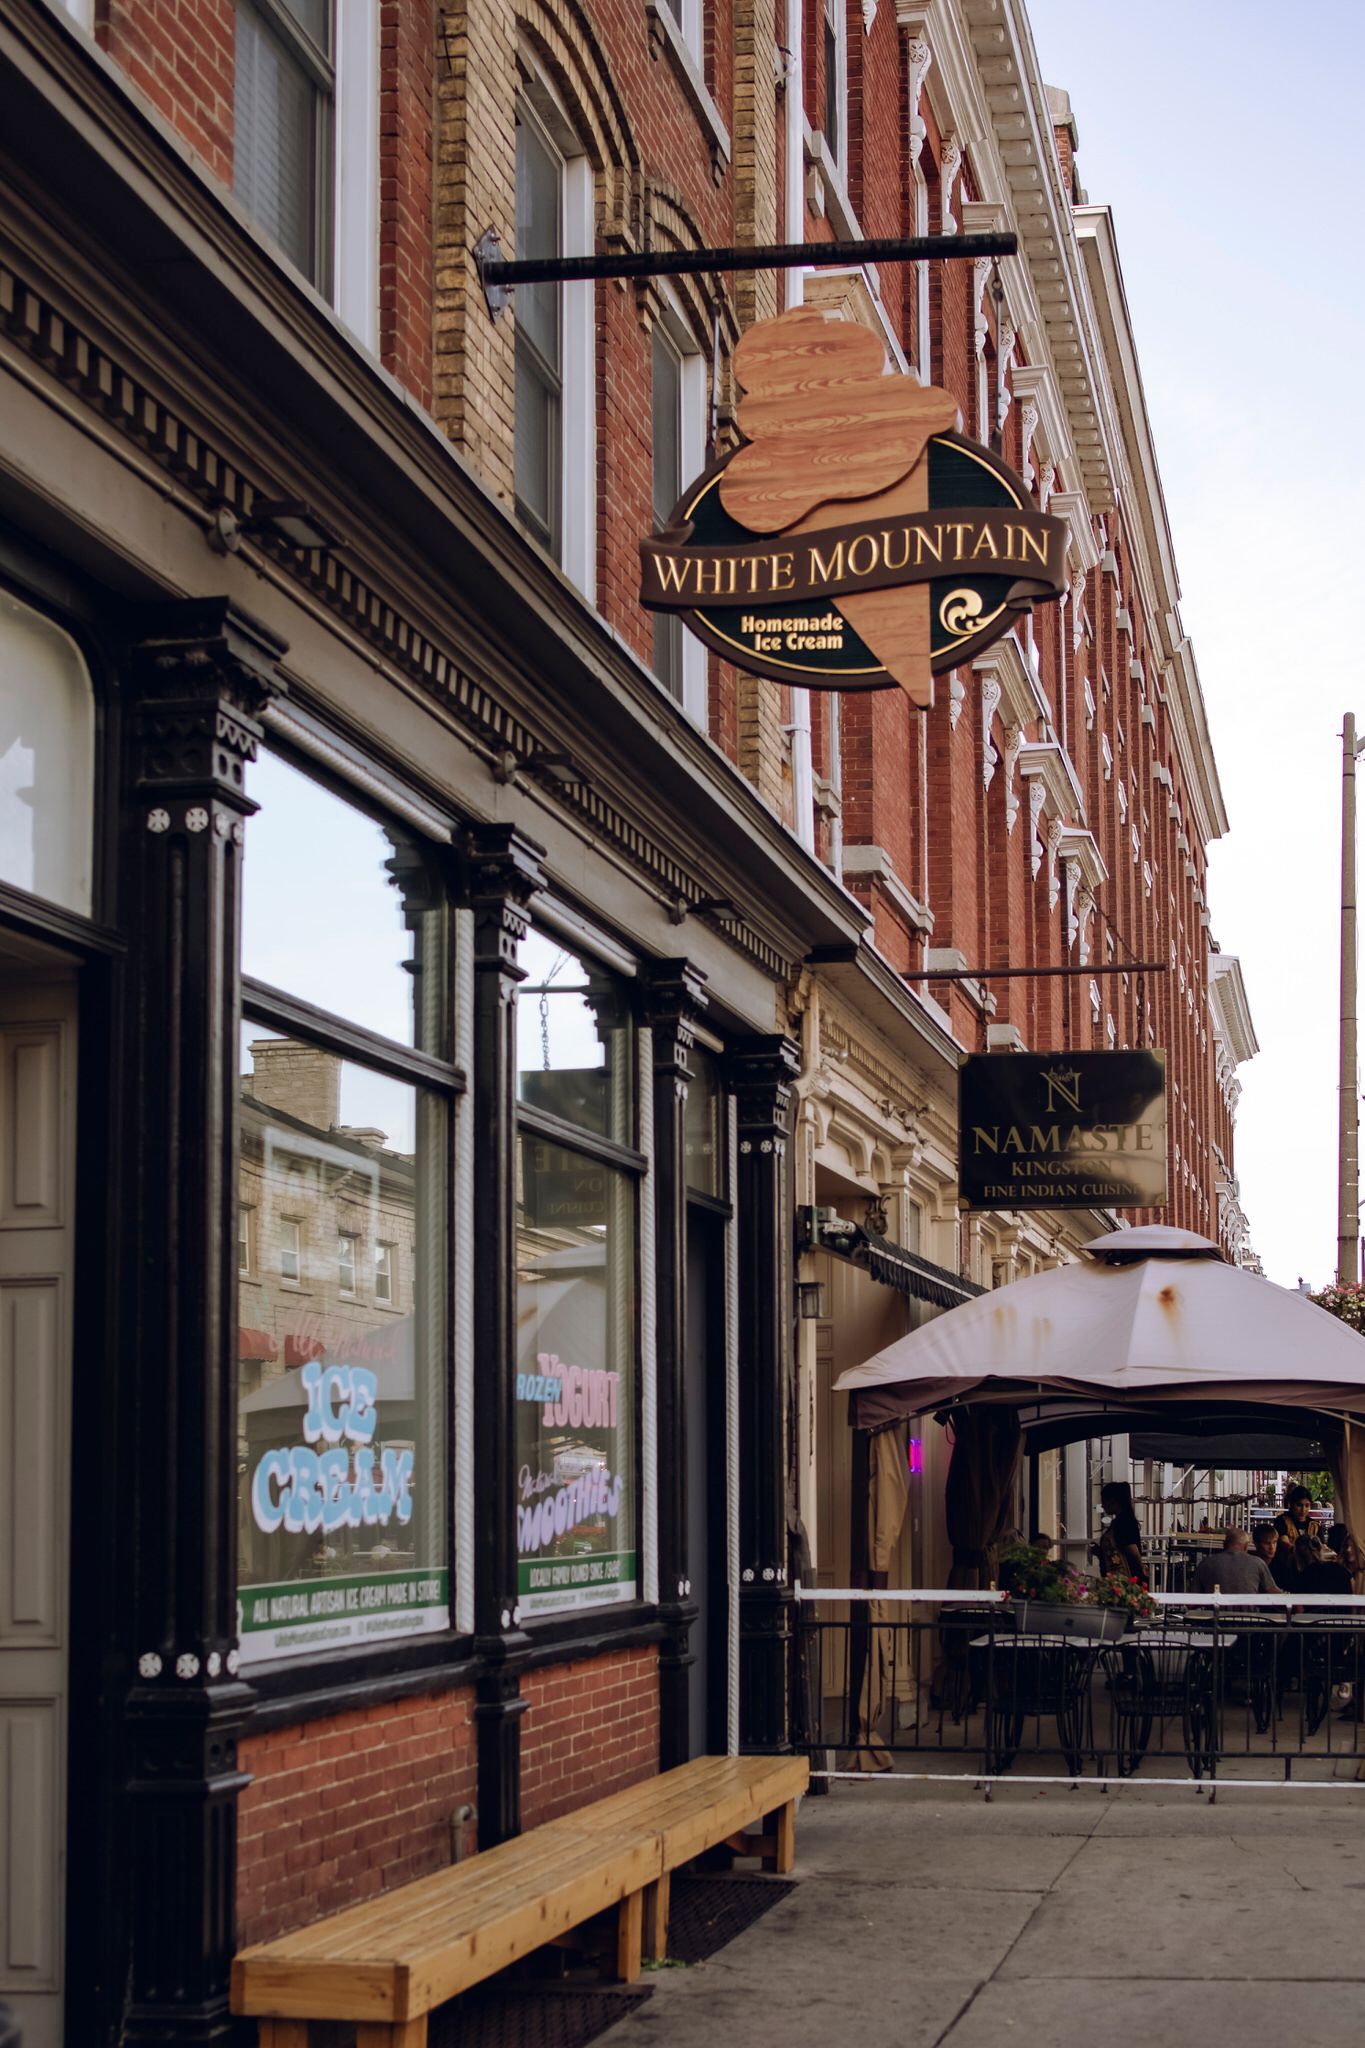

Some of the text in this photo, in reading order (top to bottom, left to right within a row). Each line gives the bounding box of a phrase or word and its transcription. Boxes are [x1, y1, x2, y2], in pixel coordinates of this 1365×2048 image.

[653, 521, 1052, 595] WHITE MOUNTAIN
[741, 612, 844, 633] Homemade
[754, 632, 843, 651] Ice Cream
[971, 1123, 1154, 1155] NAMASTE
[1011, 1159, 1112, 1177] KINGSTON
[984, 1182, 1138, 1198] FINE INDIAN CUISIN
[301, 1361, 378, 1444] ICE
[516, 1373, 562, 1403] ROZEN
[536, 1352, 620, 1429] YOGURT
[252, 1446, 415, 1535] CREAM
[517, 1465, 623, 1554] MOOTHIES
[530, 1568, 551, 1587] LOCALLY
[553, 1566, 570, 1585] FAMILY
[571, 1564, 588, 1583] OWNED
[590, 1562, 603, 1580] SINCE
[254, 1580, 440, 1623] ALL NATURAL ARTISAN ICE CREAM MADE IN STORE!
